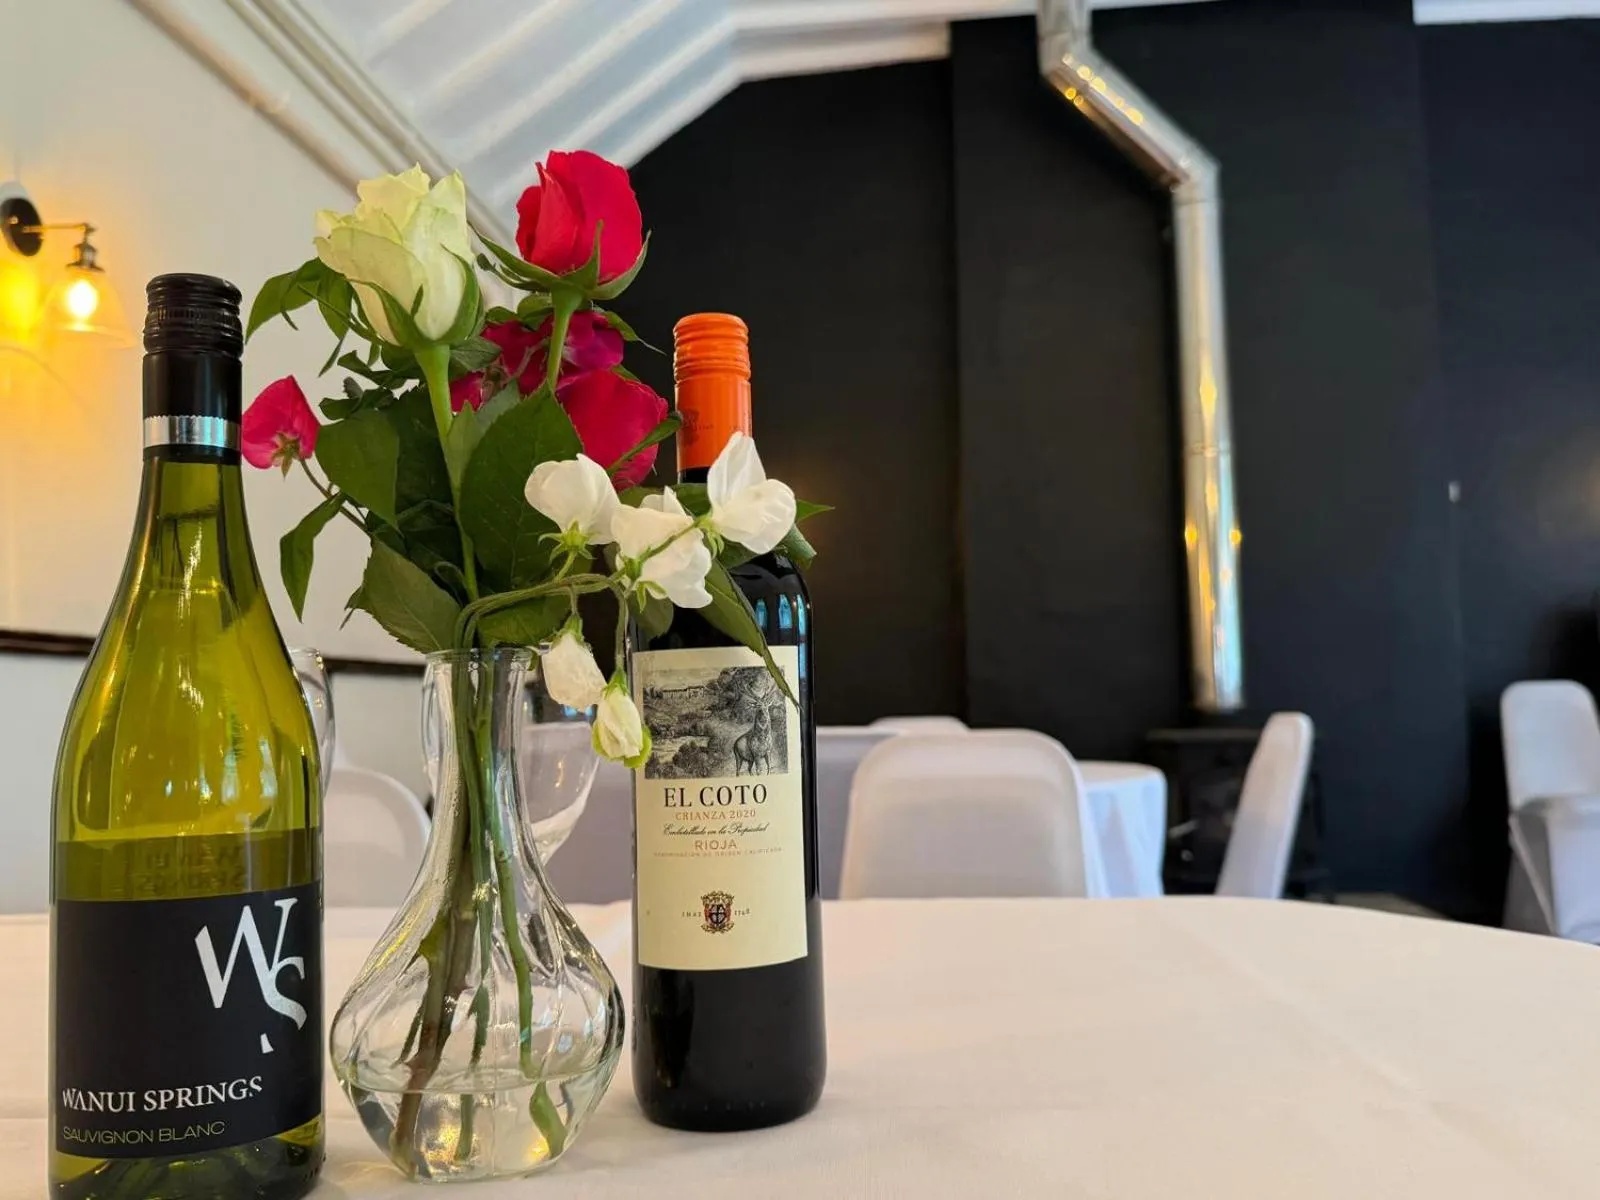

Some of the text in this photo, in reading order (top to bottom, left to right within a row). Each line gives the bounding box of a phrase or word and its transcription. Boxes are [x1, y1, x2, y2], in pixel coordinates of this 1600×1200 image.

[664, 783, 767, 808] EL COTO
[675, 809, 756, 821] CRIANZA 2020
[694, 839, 737, 851] RIOJA
[62, 1075, 262, 1113] WANUI SPRINGS
[63, 1121, 225, 1144] SAUVIGNON BLANC
